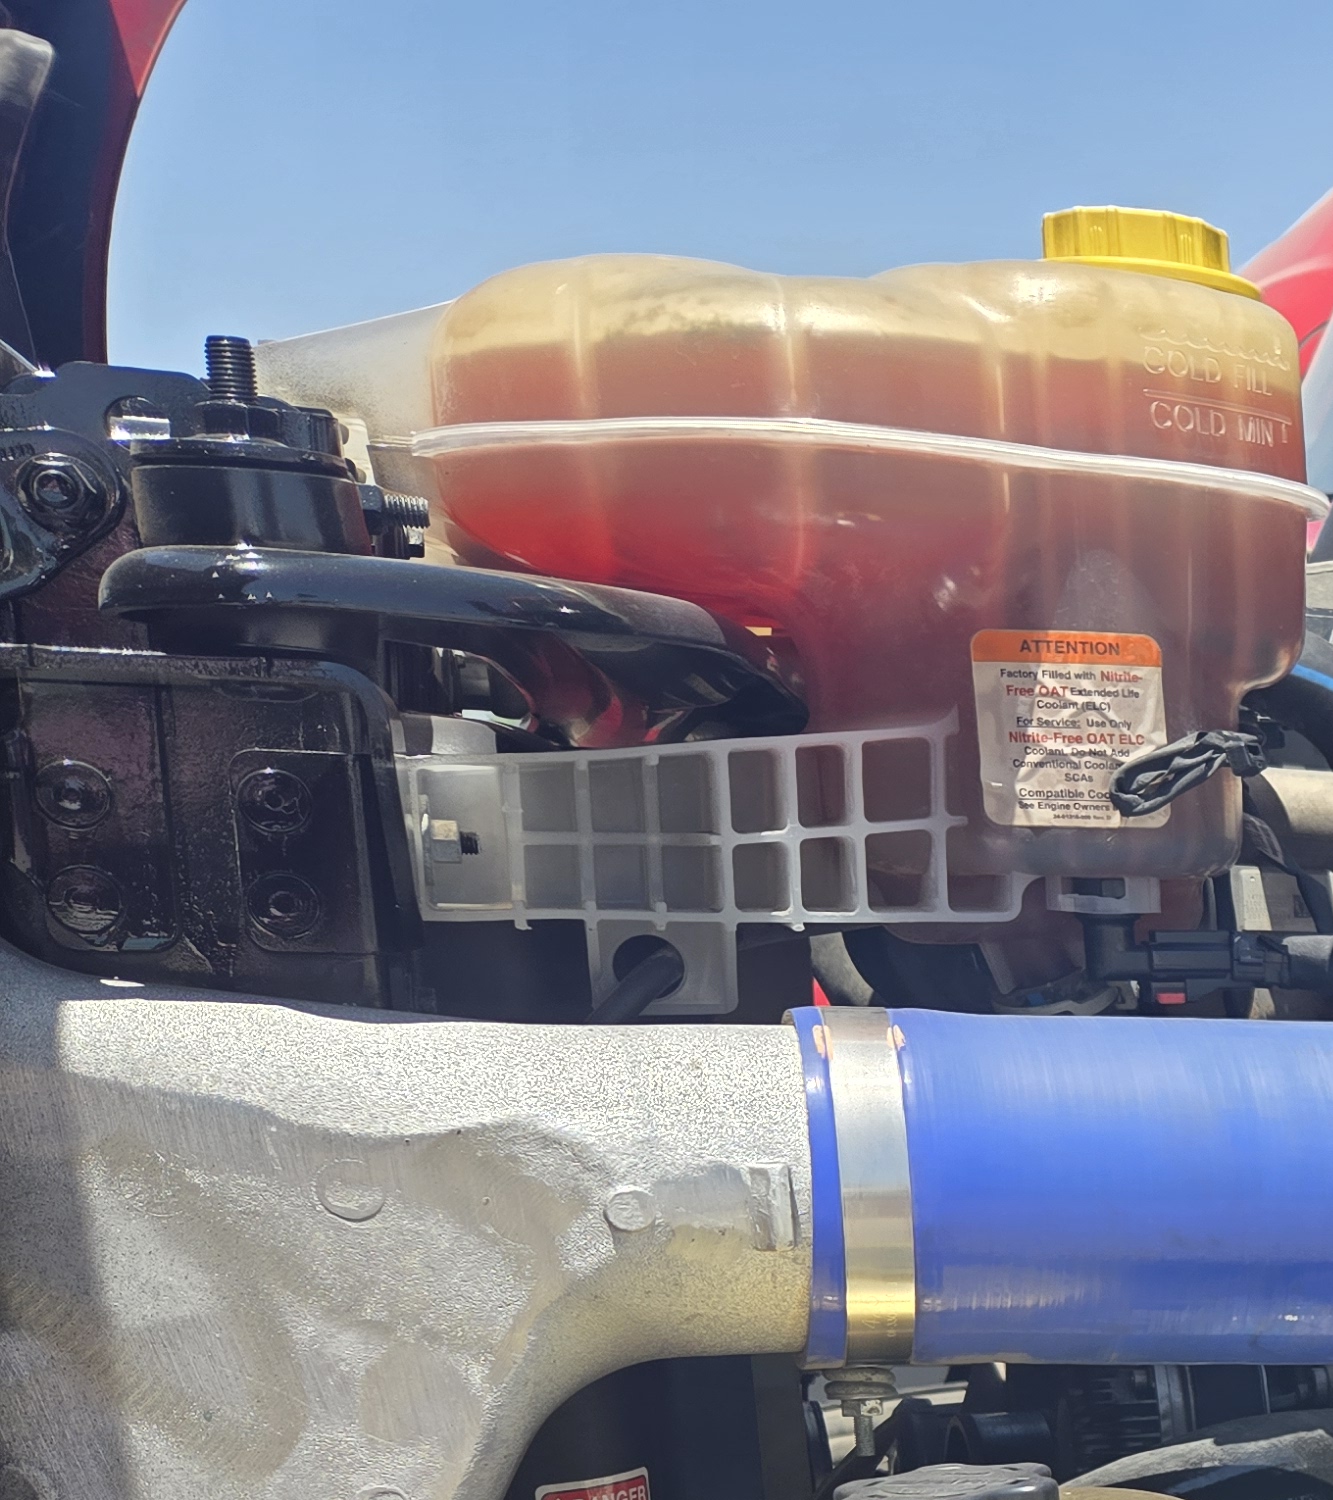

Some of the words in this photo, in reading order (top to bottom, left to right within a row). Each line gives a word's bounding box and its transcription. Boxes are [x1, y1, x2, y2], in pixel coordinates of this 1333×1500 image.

[1143, 346, 1222, 385] COLD
[1233, 362, 1273, 397] FILL
[1149, 400, 1226, 437] COLD
[1238, 414, 1274, 447] MIN
[1019, 639, 1120, 656] ATTENTION
[1000, 668, 1038, 682] Factory
[1042, 669, 1071, 681] Filled
[1074, 670, 1096, 681] with
[1006, 685, 1034, 697] Free
[1038, 685, 1068, 698] OAT
[1070, 687, 1119, 698] Extended
[1036, 700, 1080, 710] Coolant
[1081, 701, 1111, 713] (ELC)
[1016, 716, 1033, 728] For
[1037, 717, 1081, 728] Service:
[1086, 719, 1106, 729] Use
[1109, 720, 1132, 731] Only
[1008, 731, 1083, 744] Nitrite-Free
[1086, 733, 1115, 745] OAT
[1119, 734, 1145, 746] ELC
[1012, 759, 1081, 770] Conventional
[1084, 760, 1121, 770] Coolan
[1065, 773, 1094, 783] SCAs
[1019, 788, 1085, 801] Compatible
[1018, 801, 1034, 810] See
[1038, 801, 1070, 812] Engine
